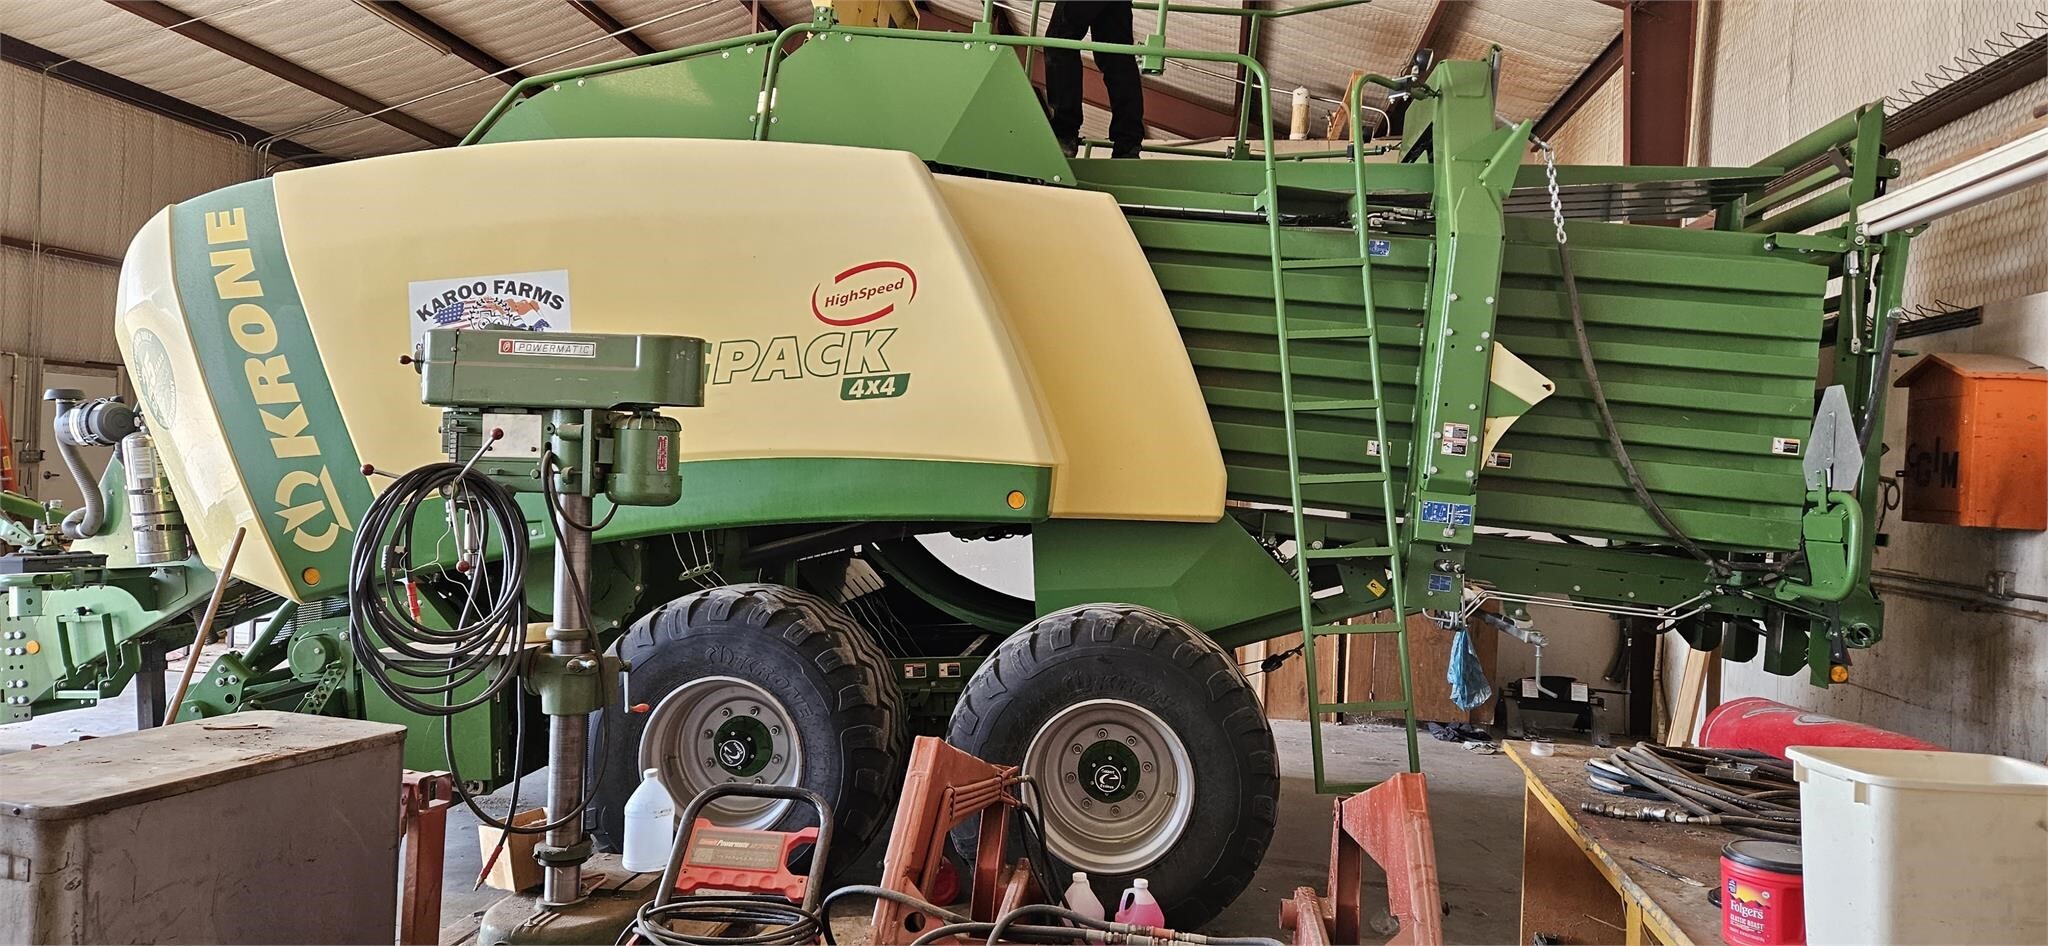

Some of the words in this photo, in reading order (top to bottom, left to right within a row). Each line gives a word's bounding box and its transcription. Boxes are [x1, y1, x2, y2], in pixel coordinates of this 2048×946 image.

[416, 281, 487, 322] KAROO
[493, 280, 565, 310] FARMS
[824, 278, 905, 309] HighSpeed
[205, 207, 321, 459] KRONE
[518, 343, 591, 354] POWERMATIC
[848, 378, 896, 399] 4x4
[1730, 900, 1764, 920] Folgers
